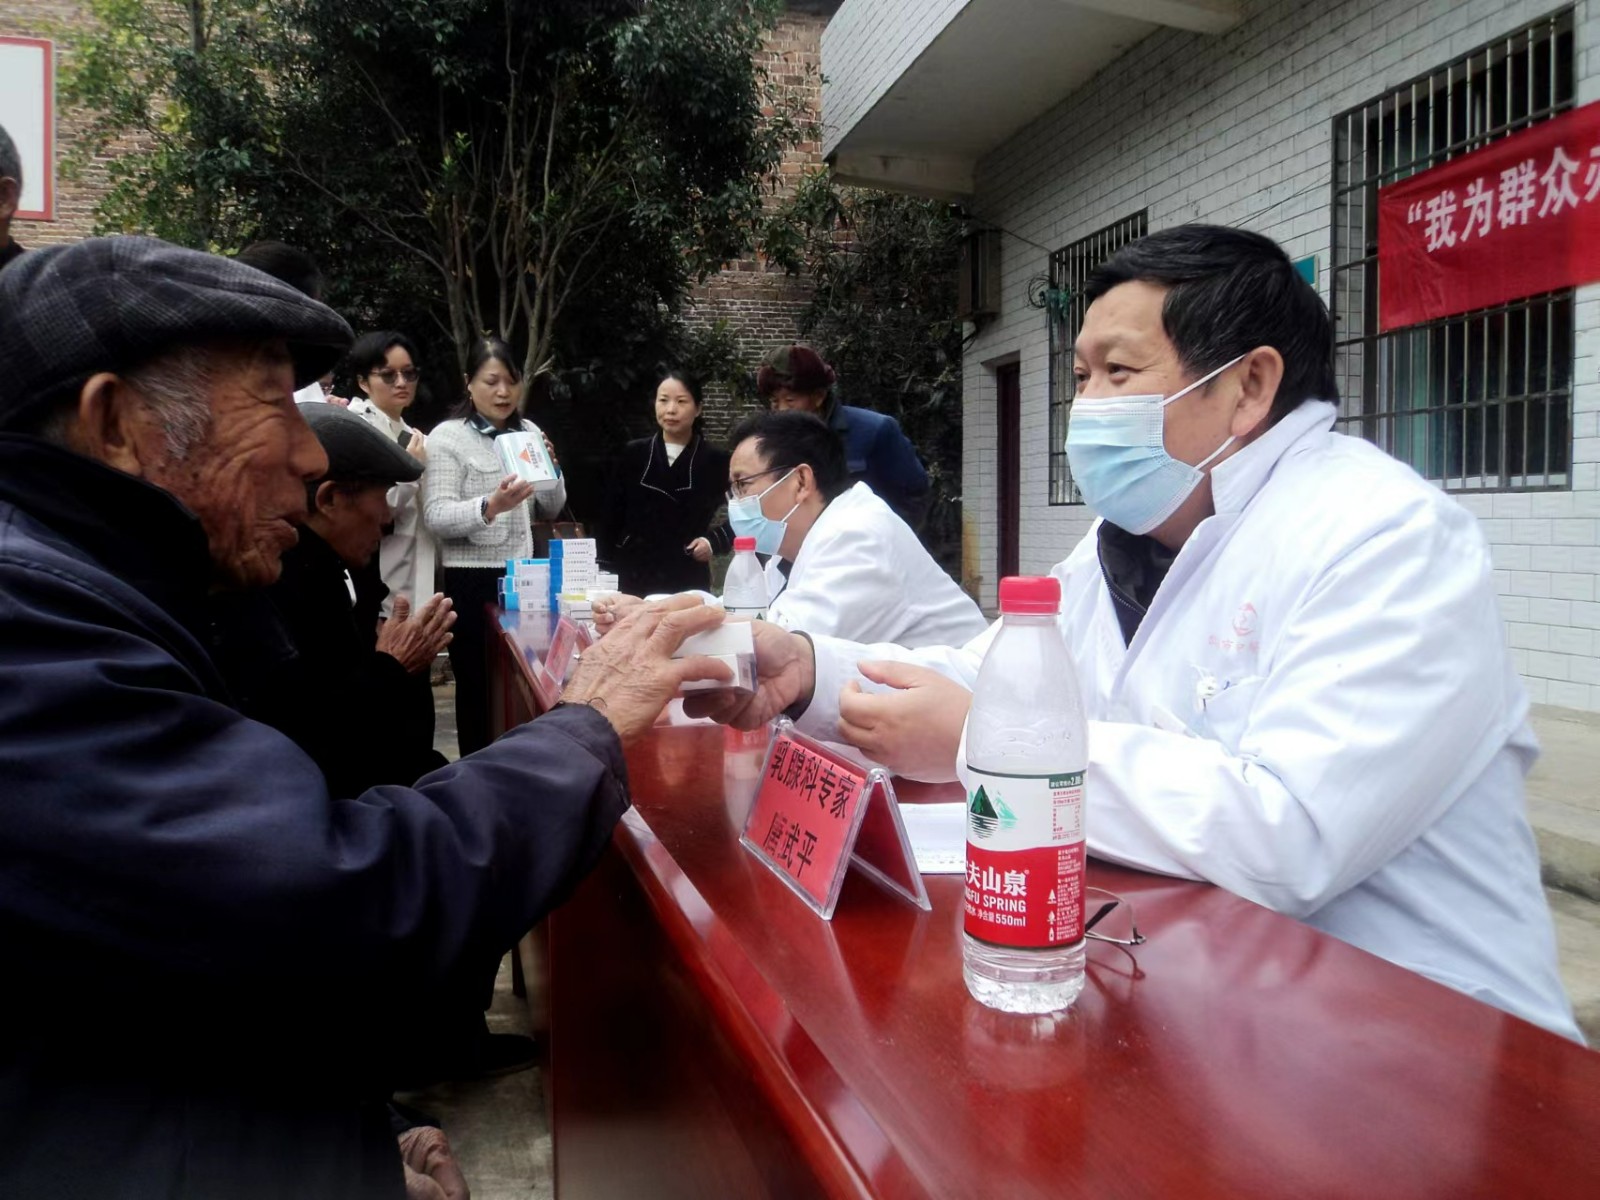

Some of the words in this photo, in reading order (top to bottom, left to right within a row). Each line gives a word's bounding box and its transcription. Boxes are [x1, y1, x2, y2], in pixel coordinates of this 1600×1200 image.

[769, 740, 857, 820] 乳腺科专家
[966, 860, 1027, 897] 夫山泉
[983, 894, 1027, 913] SPRING
